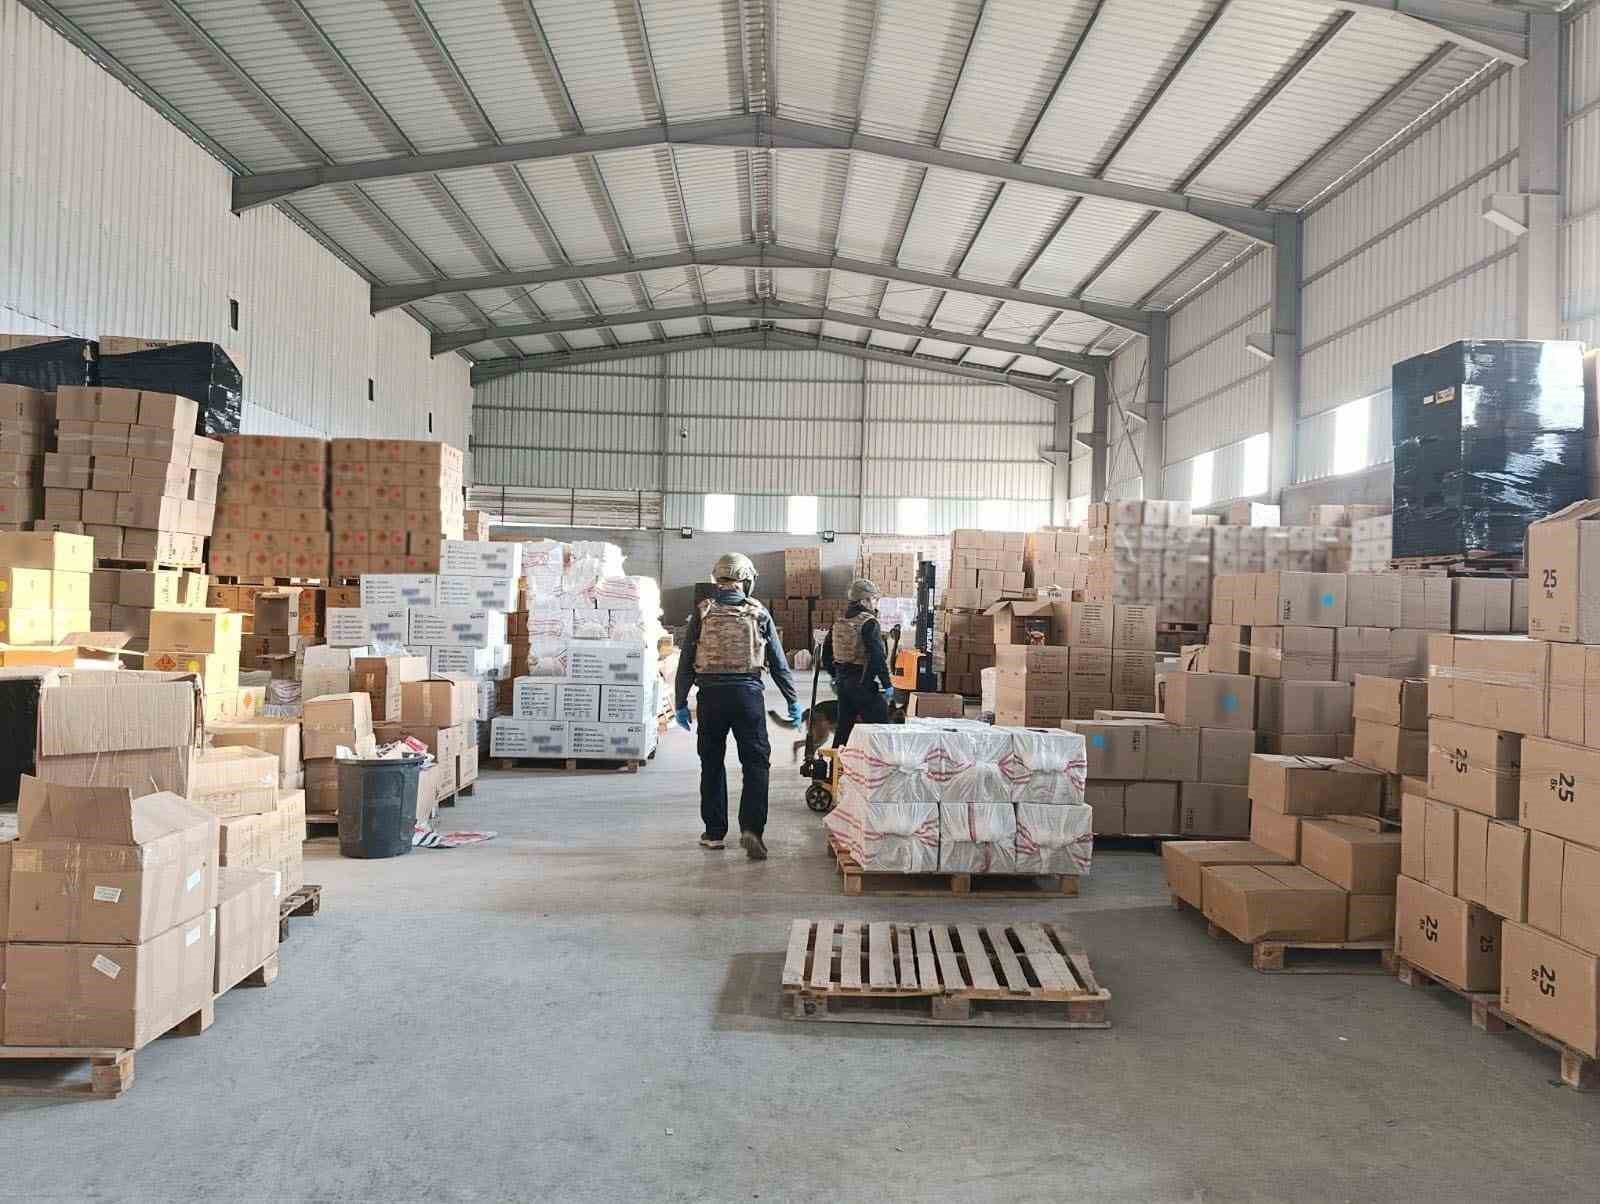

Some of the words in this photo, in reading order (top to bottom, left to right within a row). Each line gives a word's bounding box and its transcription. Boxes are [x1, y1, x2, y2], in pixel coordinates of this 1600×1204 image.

[1543, 569, 1557, 588] 25
[1456, 748, 1467, 773] 25
[1558, 772, 1575, 803] 25
[1426, 915, 1438, 942] 25
[1479, 935, 1494, 953] 25
[1540, 964, 1556, 997] 25
